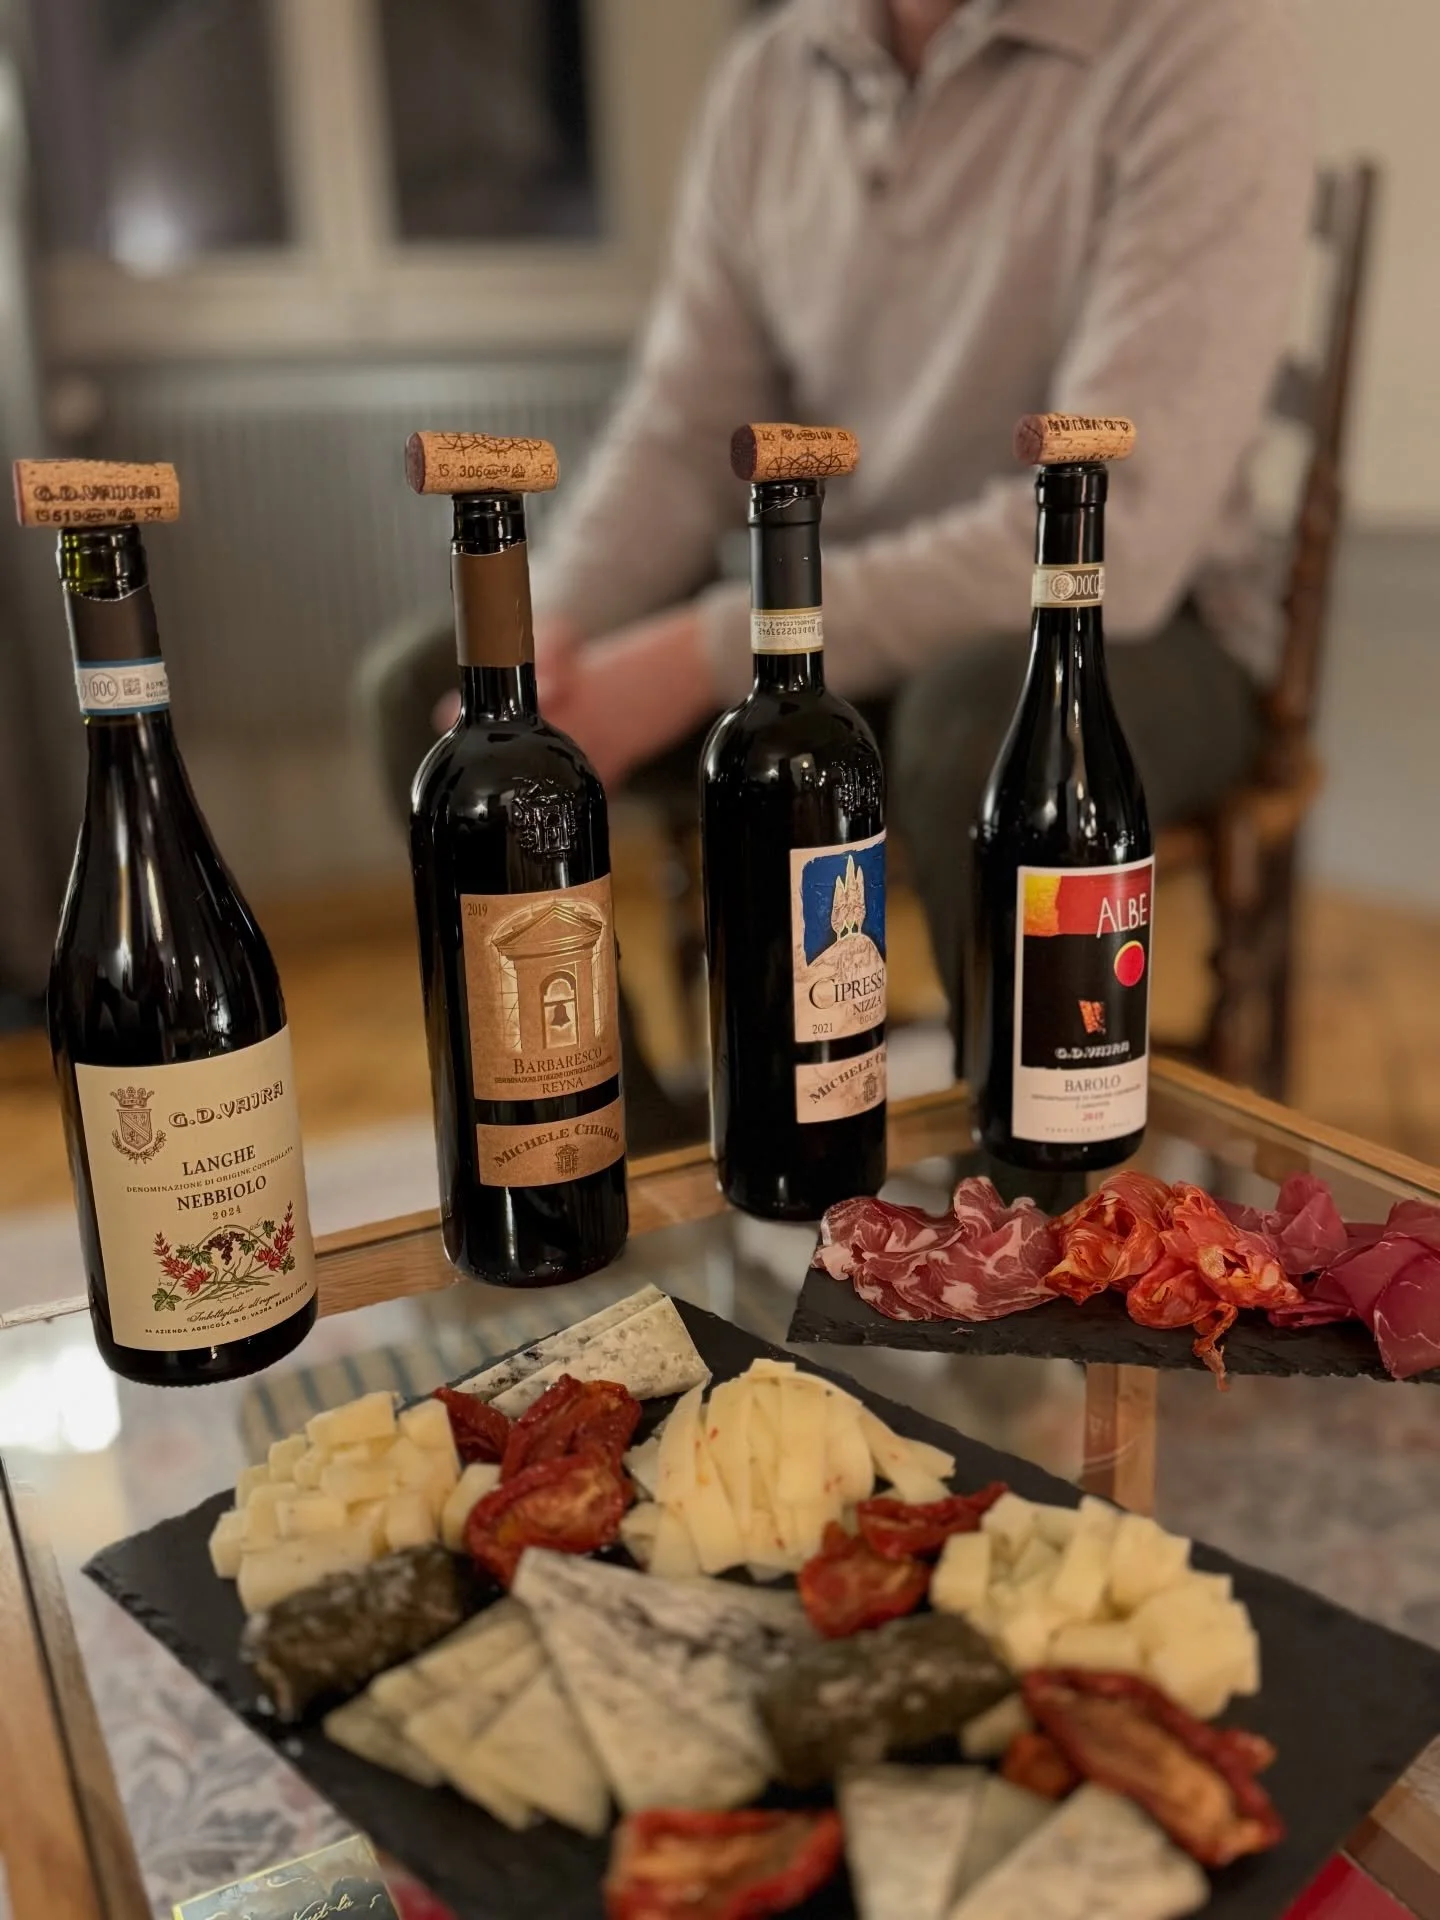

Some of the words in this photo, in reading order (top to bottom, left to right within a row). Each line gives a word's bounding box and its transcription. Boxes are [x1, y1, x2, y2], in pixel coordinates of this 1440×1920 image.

[459, 465, 482, 478] 306
[92, 681, 115, 697] DOC
[467, 902, 488, 917] 2019
[1096, 893, 1148, 938] ALBE
[852, 994, 882, 1016] NIZZA
[812, 1022, 833, 1035] 2021
[512, 1047, 602, 1075] BARBARESCO
[542, 1077, 584, 1094] REYNA
[808, 1057, 873, 1104] MICHELE
[1064, 1074, 1121, 1092] BAROLO
[168, 1080, 284, 1128] G.D.VAJRA
[493, 1128, 570, 1168] MICHELE
[574, 1124, 620, 1143] CHIARLO
[182, 1144, 256, 1176] LANGHE
[126, 1180, 202, 1193] DENOMINAZIONE
[204, 1178, 215, 1187] DI
[216, 1168, 252, 1183] ORIGINE
[176, 1176, 267, 1211] NEBBIOLO
[192, 1320, 231, 1333] AGRICOLA
